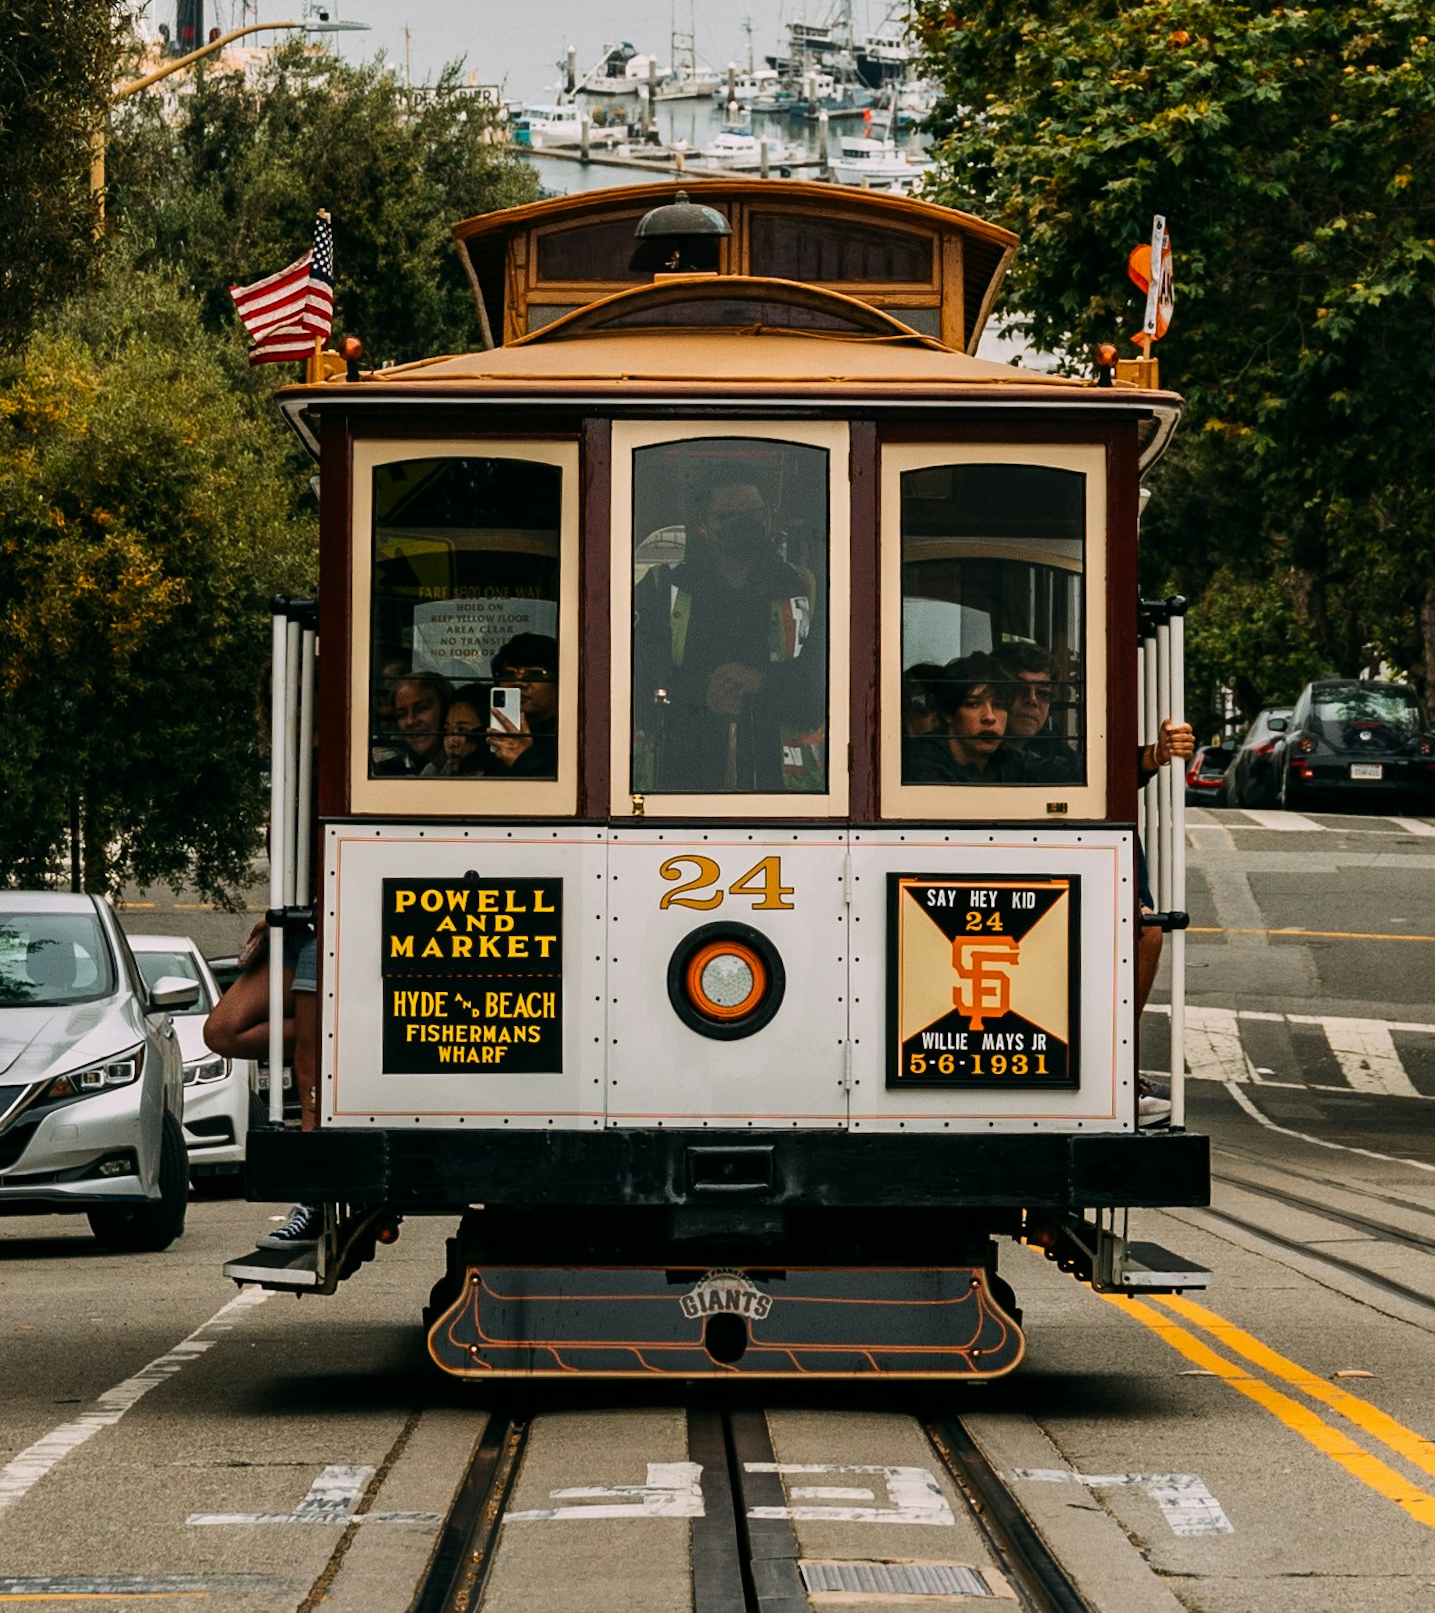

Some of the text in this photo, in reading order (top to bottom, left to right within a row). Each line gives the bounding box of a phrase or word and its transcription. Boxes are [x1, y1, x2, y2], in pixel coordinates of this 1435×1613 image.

[418, 586, 448, 599] FARE
[484, 586, 510, 600] ONE
[515, 585, 542, 599] WAY
[456, 604, 484, 612] HOLD
[431, 615, 454, 623] KEEP
[457, 615, 494, 623] YELLOW
[446, 626, 514, 634] AREA CLEAR
[440, 637, 456, 645] NO
[450, 649, 478, 657] FOOD
[659, 854, 795, 911] 24
[394, 889, 555, 913] POWELL
[926, 889, 1037, 909] SAY HEY KID
[436, 914, 515, 932] AND
[965, 911, 1004, 932] 24
[390, 935, 557, 958] MARKET
[952, 935, 1020, 1031] SF
[393, 991, 556, 1019] HYDE AND BEACH
[406, 1024, 542, 1043] FISHERMANS
[922, 1032, 1047, 1051] WILLIE MAYS JR
[437, 1046, 509, 1063] WHARF
[910, 1053, 1049, 1075] 5-6-1931
[681, 1289, 772, 1317] GIANTS
